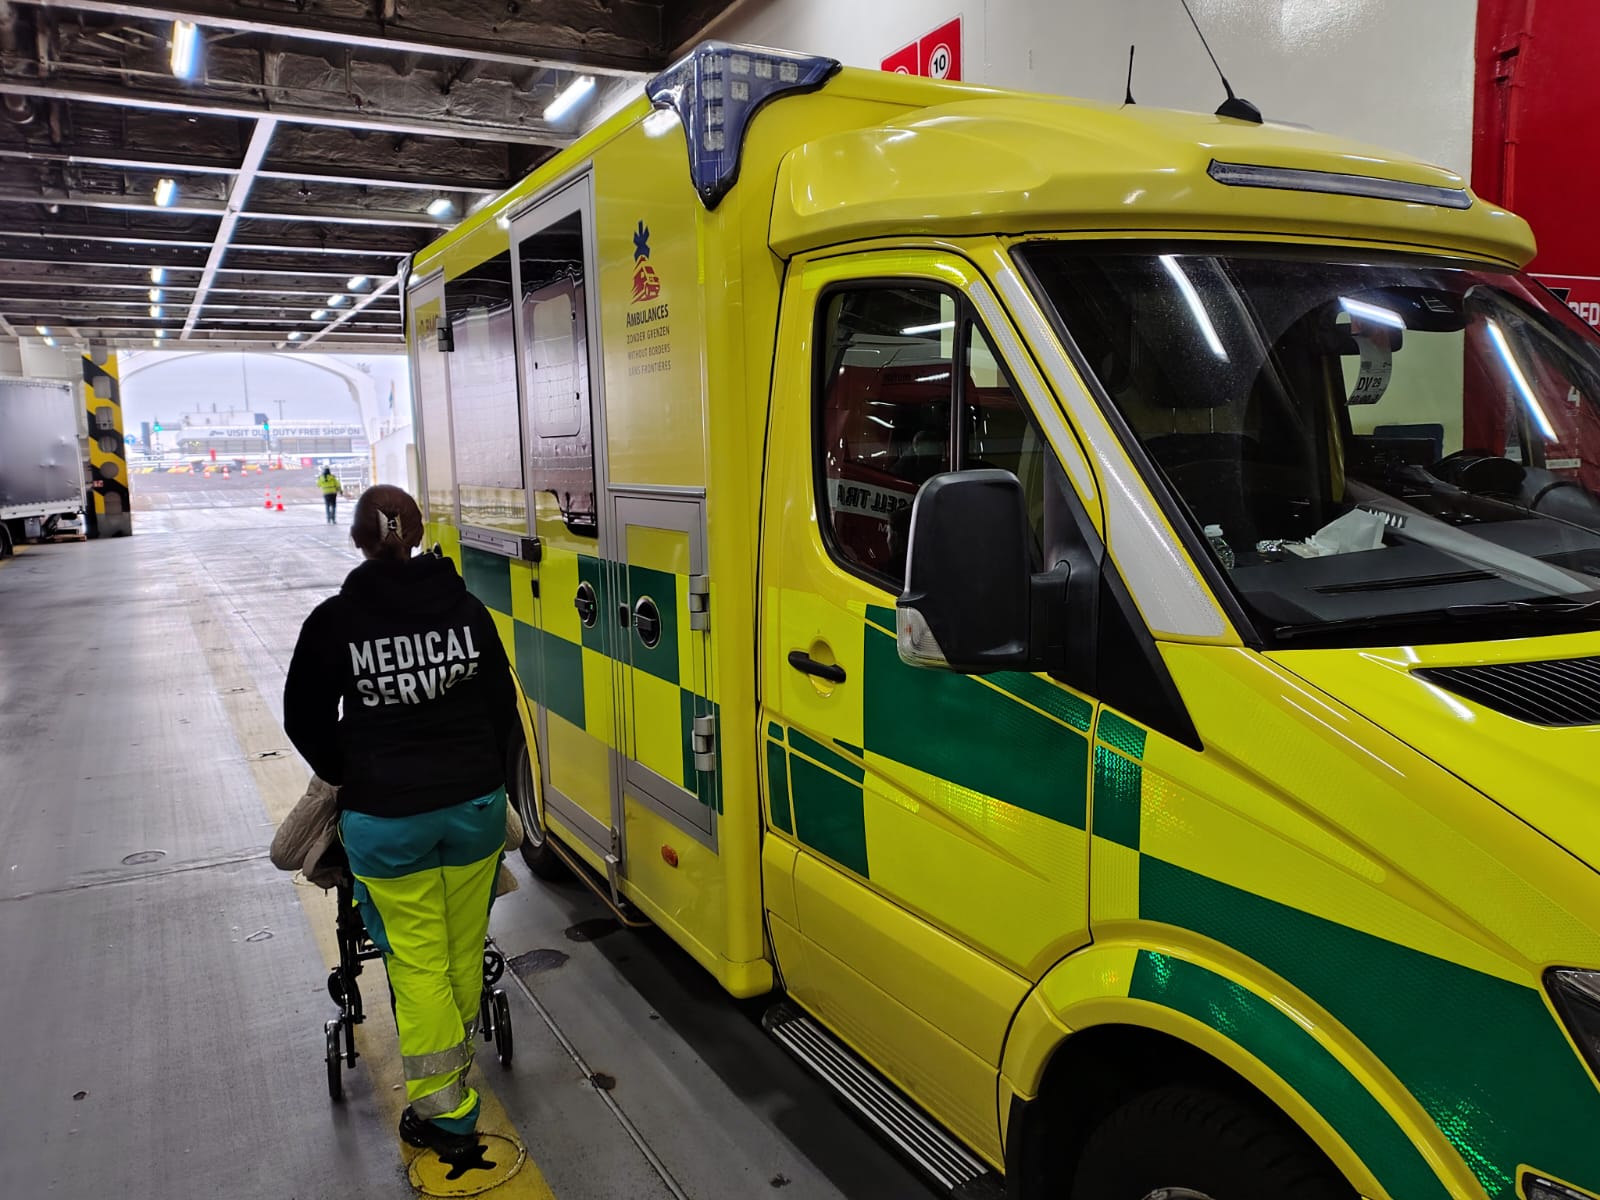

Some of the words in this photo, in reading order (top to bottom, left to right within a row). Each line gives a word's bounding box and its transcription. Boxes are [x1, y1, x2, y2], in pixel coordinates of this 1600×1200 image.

[932, 53, 947, 75] 10
[626, 303, 669, 328] AMBULANCES
[626, 331, 646, 345] ZONDER
[646, 325, 670, 340] GRENZEN
[648, 343, 671, 357] BORDERS
[226, 428, 249, 437] VISIT
[251, 428, 269, 437] OU
[272, 428, 297, 437] DUTY
[298, 427, 321, 436] FREE
[322, 427, 346, 436] SHOP
[347, 426, 361, 436] ON
[348, 625, 481, 676] MEDICAL
[356, 662, 479, 707] SERVICE
